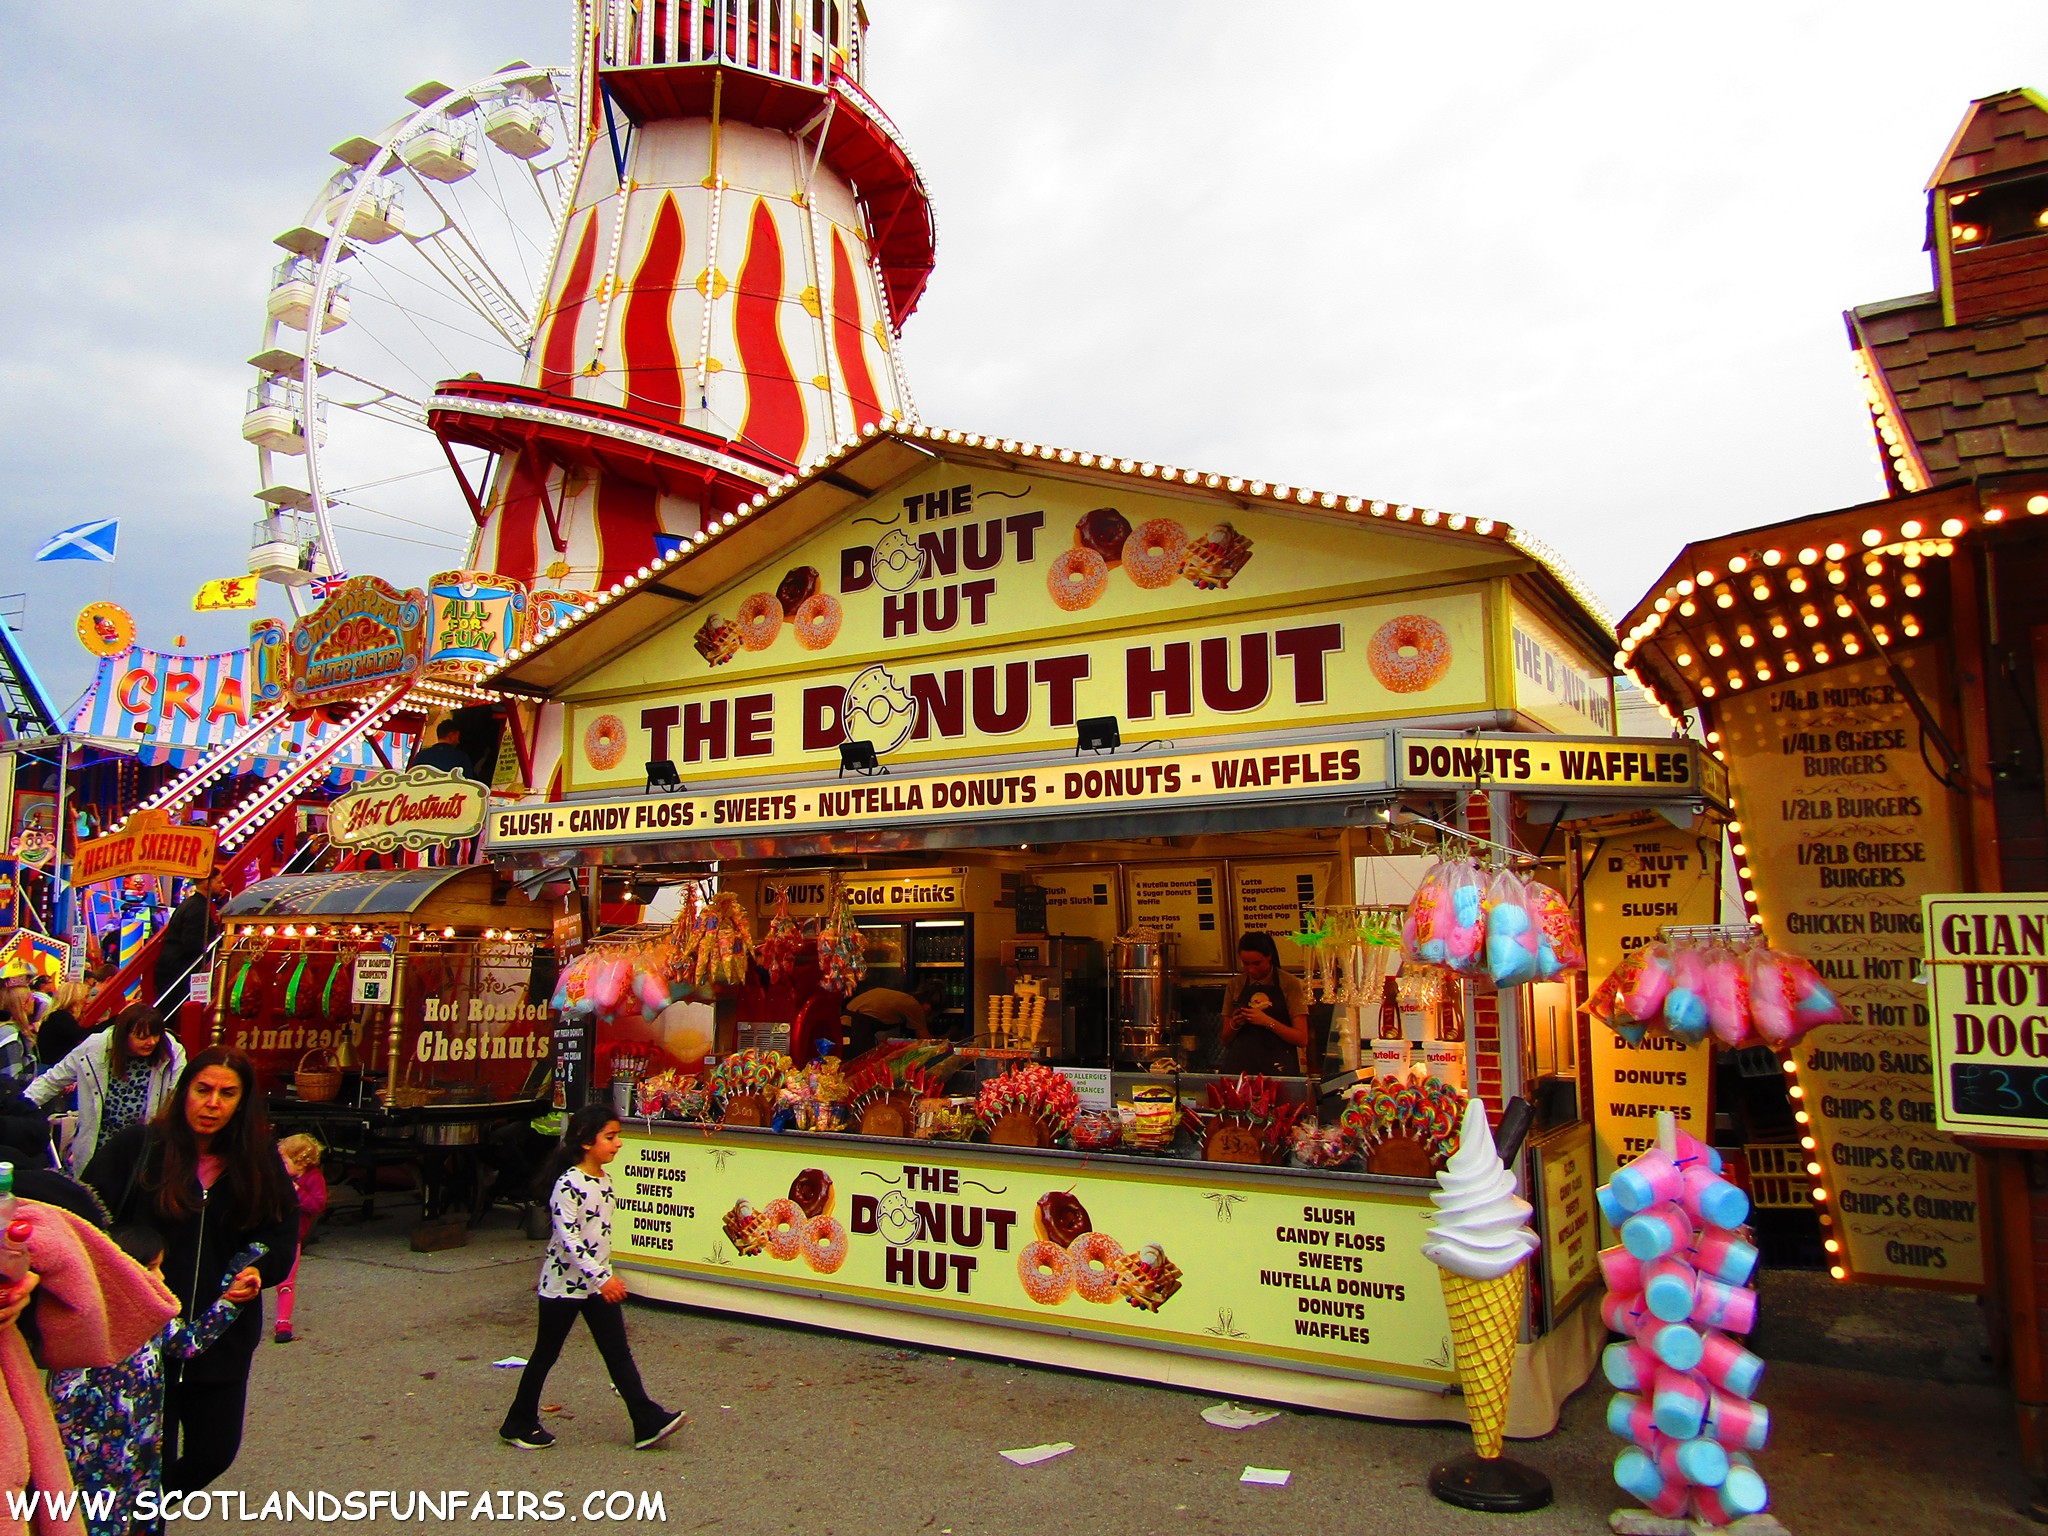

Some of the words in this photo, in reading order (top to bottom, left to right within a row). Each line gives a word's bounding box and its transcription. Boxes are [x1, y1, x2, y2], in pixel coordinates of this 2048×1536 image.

[903, 484, 972, 522] THE
[840, 510, 1046, 595] DONUT
[442, 599, 491, 620] ALL
[882, 579, 997, 639] HUT
[449, 618, 481, 631] FOR
[440, 629, 497, 652] FUN
[306, 658, 352, 690] HELTER
[352, 647, 404, 680] SKELTER
[1512, 625, 1542, 685] THE
[1588, 686, 1610, 733] HUT
[640, 693, 775, 765] THE
[802, 653, 1092, 755] DONUT
[1125, 621, 1344, 722] HUT
[1823, 685, 1905, 708] BURGER
[1835, 729, 1907, 752] CHEESE
[1409, 745, 1531, 783] DONUTS
[1560, 750, 1690, 785] WAFFLES
[1803, 754, 1887, 777] BURGERS
[499, 805, 553, 838] SLUSH
[569, 807, 630, 834] CANDY
[635, 803, 694, 828] FLOSS
[713, 794, 797, 825] SWEETS
[817, 784, 923, 819] NUTELLA
[932, 775, 1037, 810] DONUTS
[1064, 762, 1181, 800] DONUTS
[1211, 749, 1361, 790] WAFFLES
[345, 797, 389, 834] Hot
[385, 792, 467, 826] Chestnuts
[1837, 796, 1922, 818] BURGERS
[83, 837, 136, 877] HELTER
[138, 834, 203, 868] SKELTER
[1633, 843, 1660, 853] THE
[1853, 841, 1926, 863] CHEESE
[1608, 853, 1688, 874] DONUT
[1142, 881, 1168, 889] Nutella
[1170, 880, 1197, 888] Donuts
[1627, 873, 1670, 889] HUT
[1819, 866, 1905, 889] BURGERS
[764, 884, 824, 904] DNUTS
[891, 884, 955, 904] Drinks
[1070, 896, 1093, 905] Slush
[1143, 890, 1164, 898] Sugar
[1165, 888, 1192, 896] Donuts
[1242, 887, 1286, 895] Cappuccino
[1259, 903, 1298, 911] Chocolate
[1275, 912, 1290, 920] Pop
[1622, 902, 1677, 917] SLUSH
[1138, 915, 1160, 923] Candy
[1161, 914, 1181, 922] Floss
[1165, 922, 1173, 930] Of
[1786, 912, 1865, 934] CHICKEN
[1941, 913, 2048, 956] GIAN
[1808, 958, 1859, 979] MALL
[1863, 957, 1903, 979] HOT
[424, 998, 458, 1022] Hot
[467, 998, 548, 1023] Roasted
[1867, 1003, 1908, 1026] HOT
[416, 1031, 550, 1062] Chestnuts
[1373, 1051, 1400, 1060] nutella
[1427, 1053, 1457, 1062] nutella
[1807, 1048, 1875, 1073] JUMBO
[1614, 1070, 1687, 1086] DONUTS
[1610, 1103, 1692, 1120] WAFFES
[1821, 1095, 1875, 1120] CHIPS
[1879, 1096, 1894, 1121] &
[641, 1149, 670, 1163] SLUSH
[1832, 1143, 1888, 1169] CHIPS
[1890, 1144, 1905, 1170] &
[1907, 1147, 1971, 1173] GRAVY
[625, 1165, 655, 1179] CANDY
[657, 1168, 686, 1182] FLOSS
[903, 1166, 960, 1194] THE
[636, 1183, 673, 1198] SWEETS
[656, 1203, 695, 1218] DONUTS
[1303, 1206, 1355, 1225] SLUSH
[1840, 1190, 1895, 1216] CHIPS
[1896, 1192, 1911, 1218] &
[1913, 1195, 1976, 1222] CURRY
[634, 1217, 671, 1233] DONUTS
[851, 1190, 1017, 1251] DONUT
[631, 1234, 673, 1251] WAFFLES
[1276, 1226, 1330, 1246] CANDY
[1335, 1232, 1385, 1252] FLOSS
[1298, 1251, 1363, 1273] SWEETS
[1885, 1240, 1947, 1269] CHIPS
[885, 1246, 977, 1294] HUT
[1260, 1270, 1331, 1292] NUTELLA
[1337, 1278, 1405, 1301] DONUTS
[1298, 1297, 1365, 1320] DONUTS
[1294, 1319, 1370, 1344] WAFFLES
